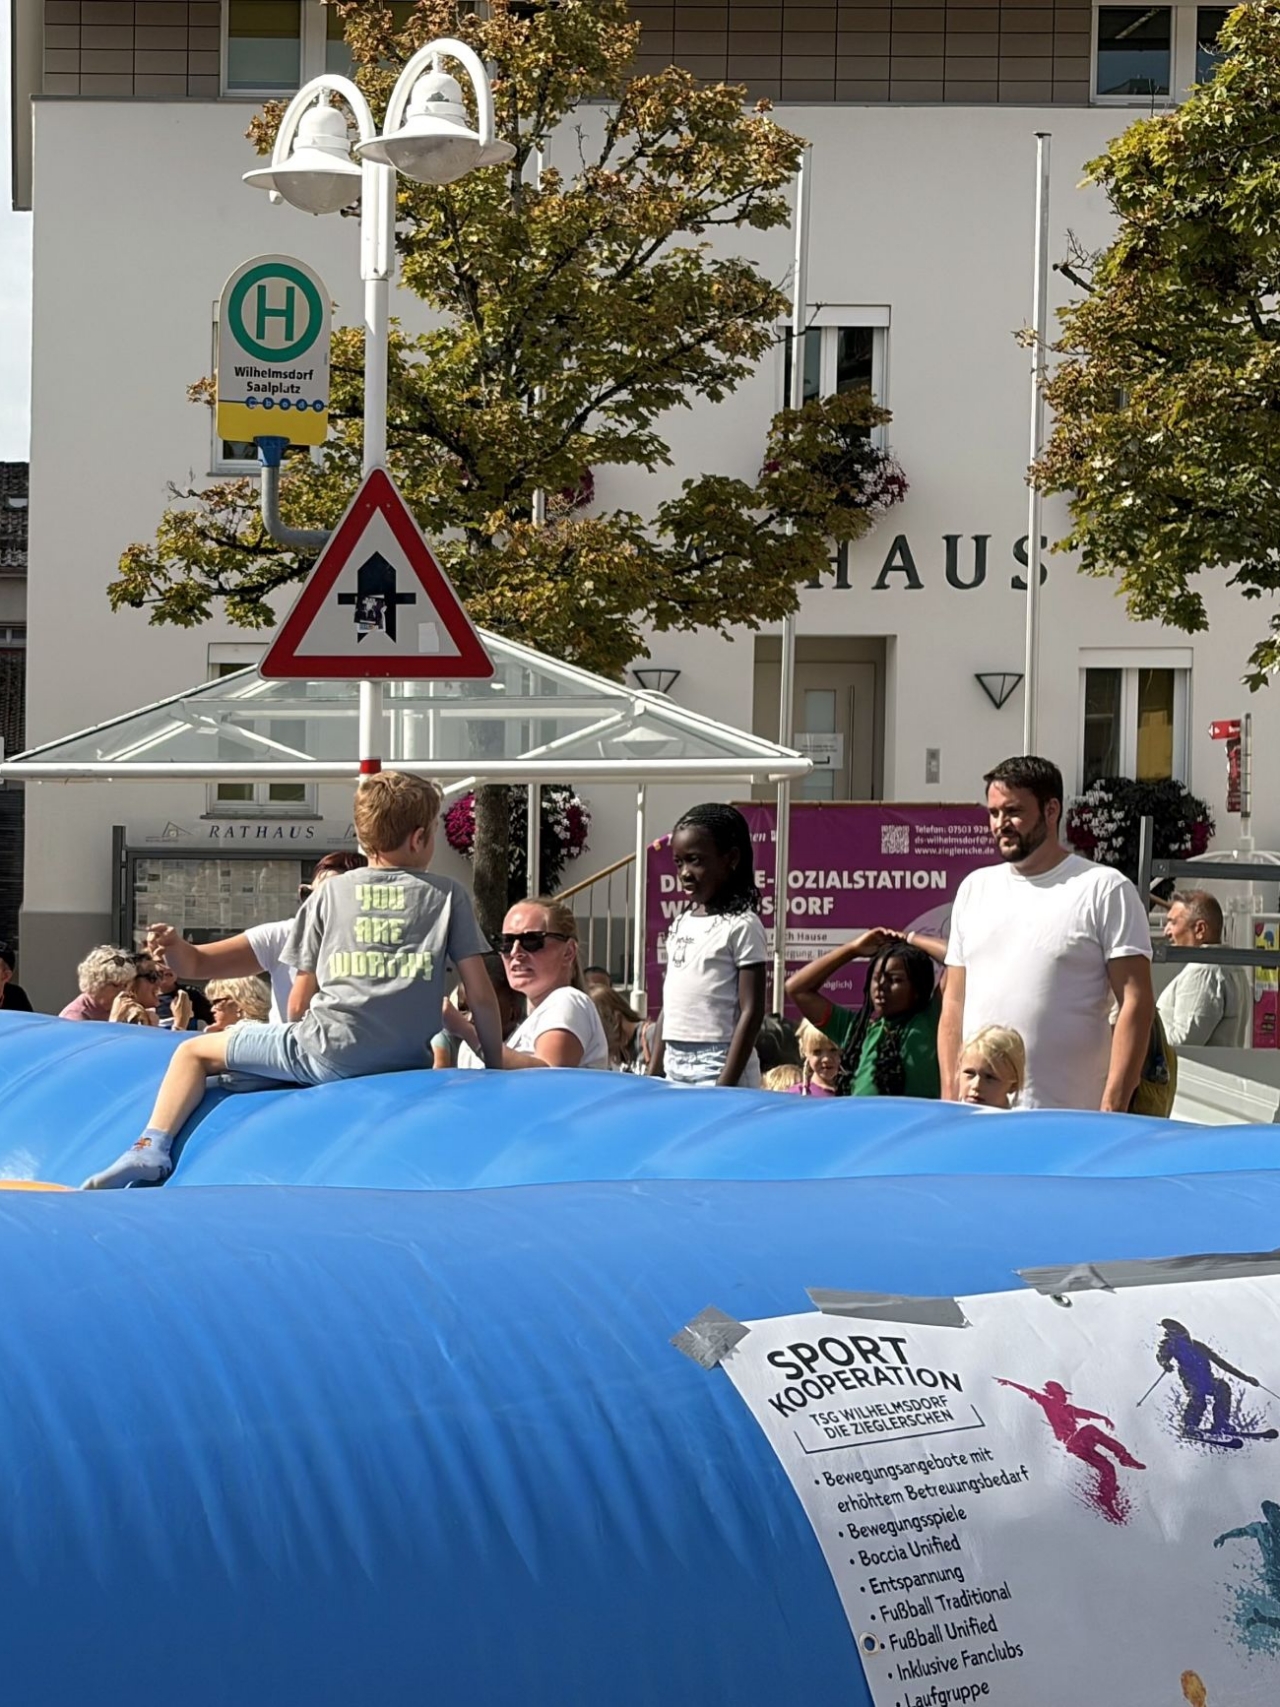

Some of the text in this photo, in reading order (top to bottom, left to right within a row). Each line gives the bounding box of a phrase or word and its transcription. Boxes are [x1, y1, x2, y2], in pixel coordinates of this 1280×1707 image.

[256, 284, 295, 342] H
[234, 366, 314, 380] Wilhelmsdorf
[247, 381, 301, 395] Saalplatz
[208, 825, 316, 839] RATHAUS
[915, 825, 946, 834] Telefon:
[355, 884, 405, 911] YOU
[354, 917, 405, 944] ARE
[797, 932, 827, 941] Hause
[329, 951, 433, 980] WORTHY
[766, 1336, 909, 1380] SPORT
[767, 1366, 964, 1418] KOOPERATION
[809, 1395, 949, 1427] TSG WILHELMSDORF
[823, 1410, 955, 1440] DIE ZIEGLERSCHEN
[822, 1447, 995, 1487] Bewegungsangebote mit
[837, 1465, 1030, 1513] erhöhtem Betreuungsbedarf
[847, 1504, 967, 1540] Bewegungsspiele
[858, 1533, 962, 1567] Boccia Unified
[868, 1566, 965, 1595] Entspannung
[879, 1581, 1012, 1622] Fußball Traditional
[888, 1613, 998, 1652] Fußball Unified
[896, 1640, 1024, 1682] Inklusive Fanclubs
[904, 1681, 990, 1707] Laufgruppe
